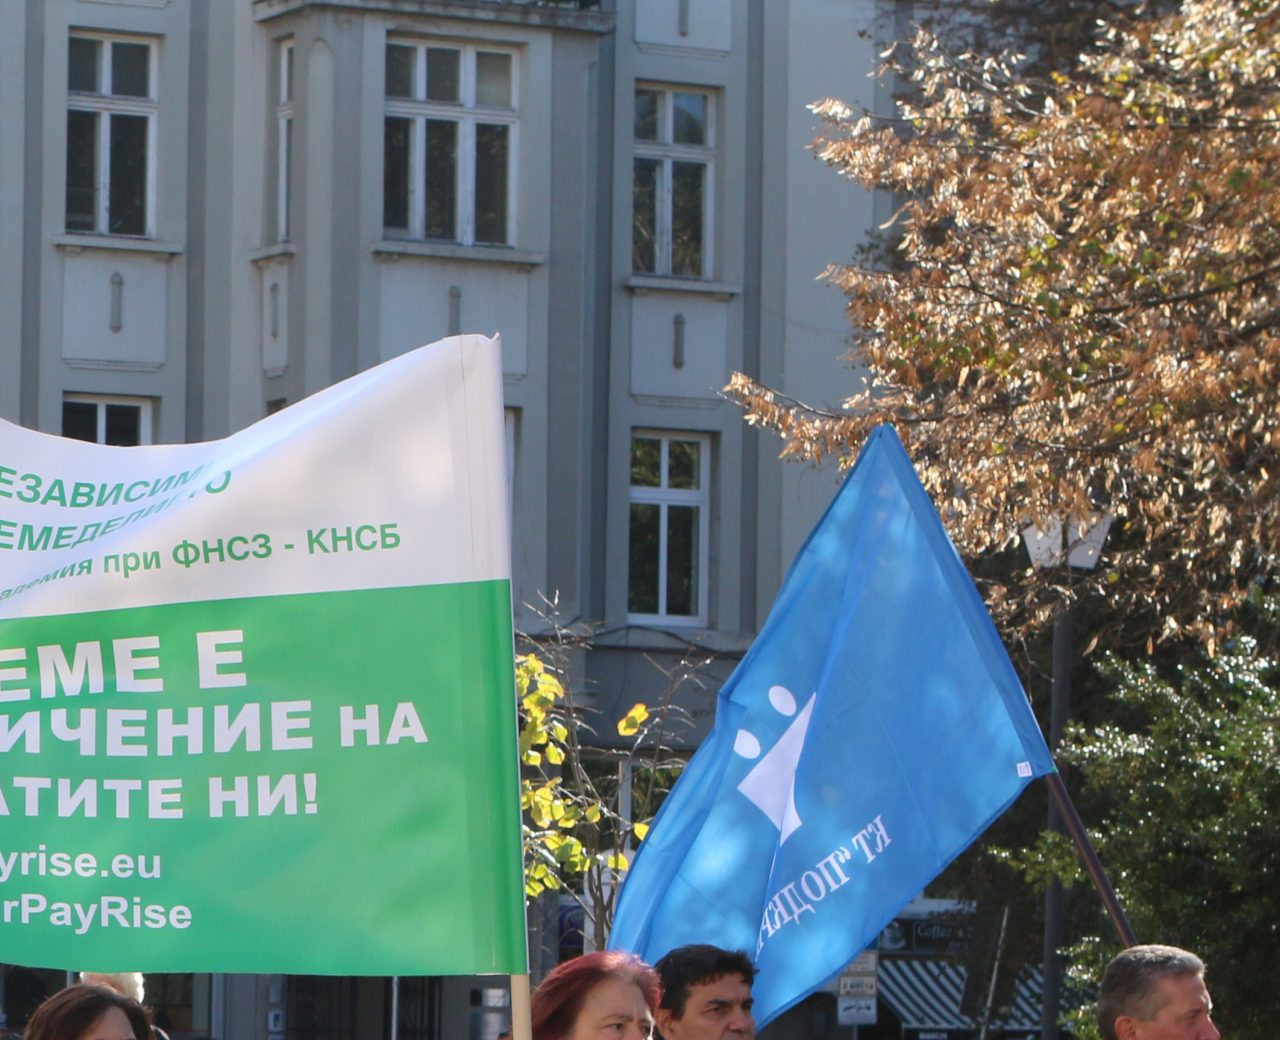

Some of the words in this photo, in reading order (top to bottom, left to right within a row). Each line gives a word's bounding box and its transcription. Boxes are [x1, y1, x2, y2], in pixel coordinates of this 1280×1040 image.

[103, 551, 161, 578] при
[172, 533, 273, 567] ФНСЗ
[307, 523, 402, 553] КНСБ
[196, 629, 247, 689] Е
[340, 702, 428, 747] НА
[209, 773, 318, 817] НИ!
